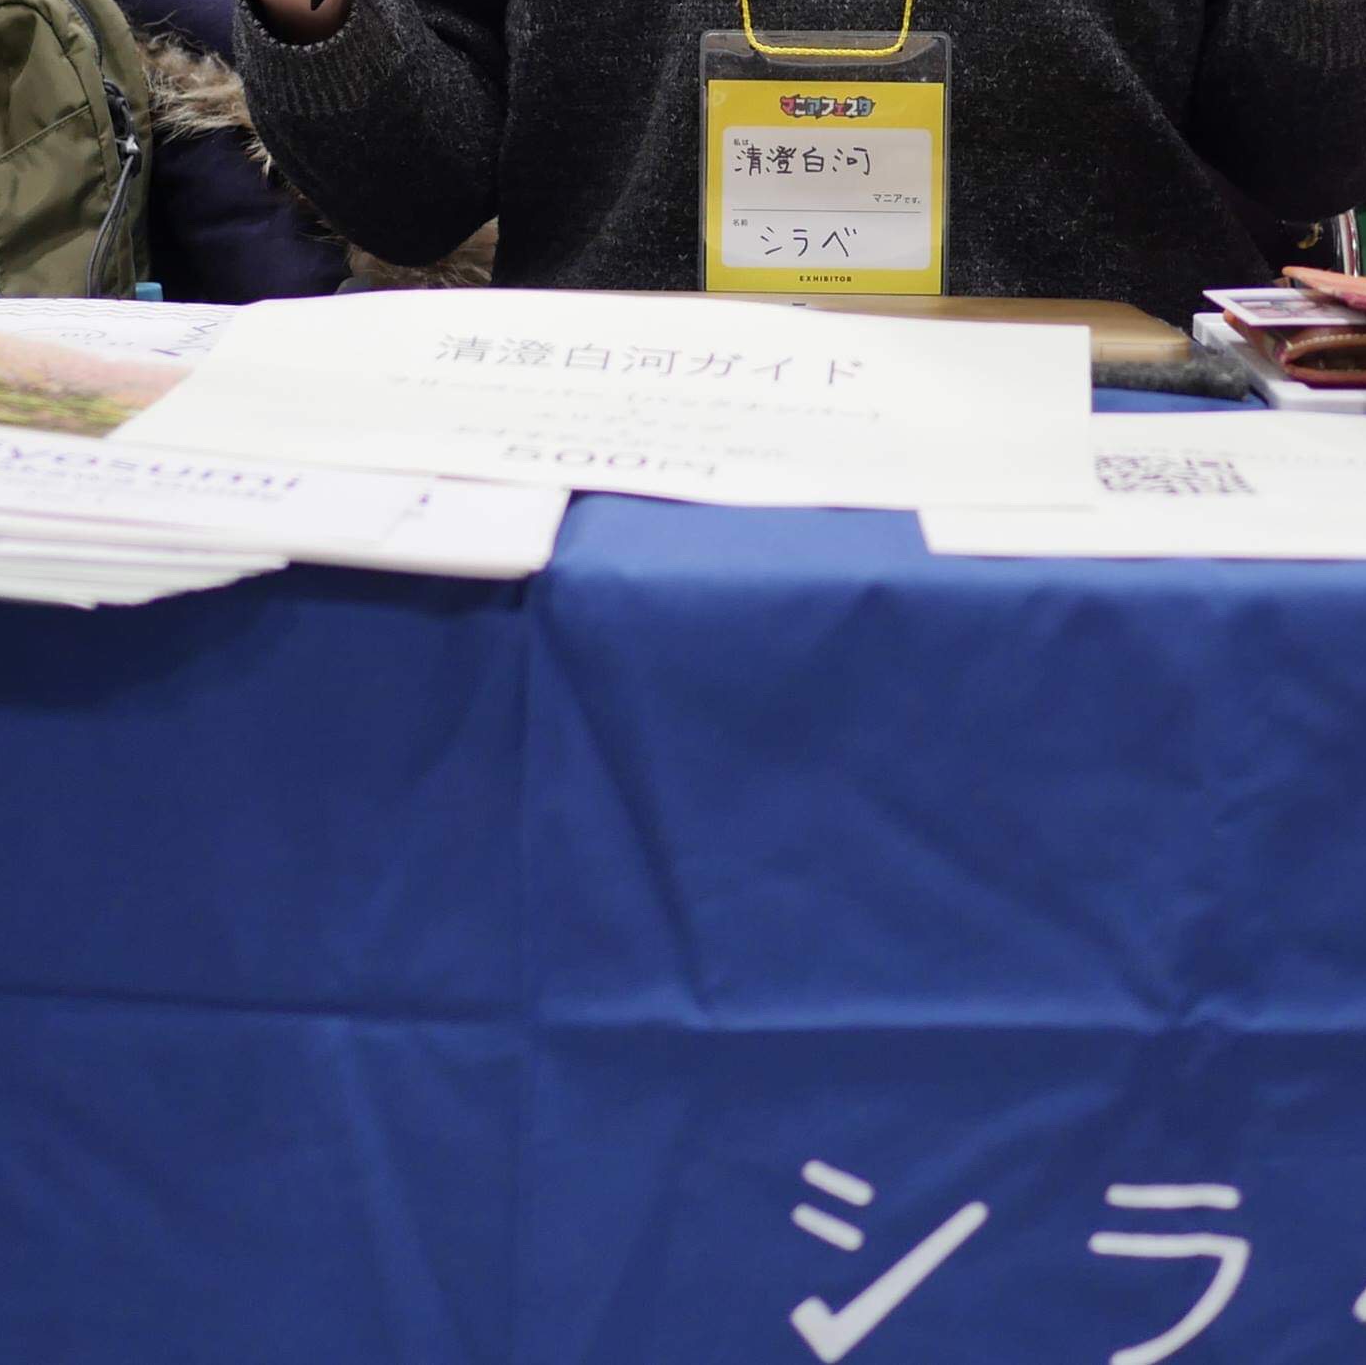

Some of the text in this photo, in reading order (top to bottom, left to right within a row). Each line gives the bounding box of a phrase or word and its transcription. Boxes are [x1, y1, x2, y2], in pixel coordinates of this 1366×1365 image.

[734, 144, 871, 176] 清澄白河
[872, 193, 922, 205] マニアです。
[760, 226, 857, 257] シラベ
[799, 274, 853, 284] EXHIBITOR
[434, 333, 863, 386] 清澄白河ガイド
